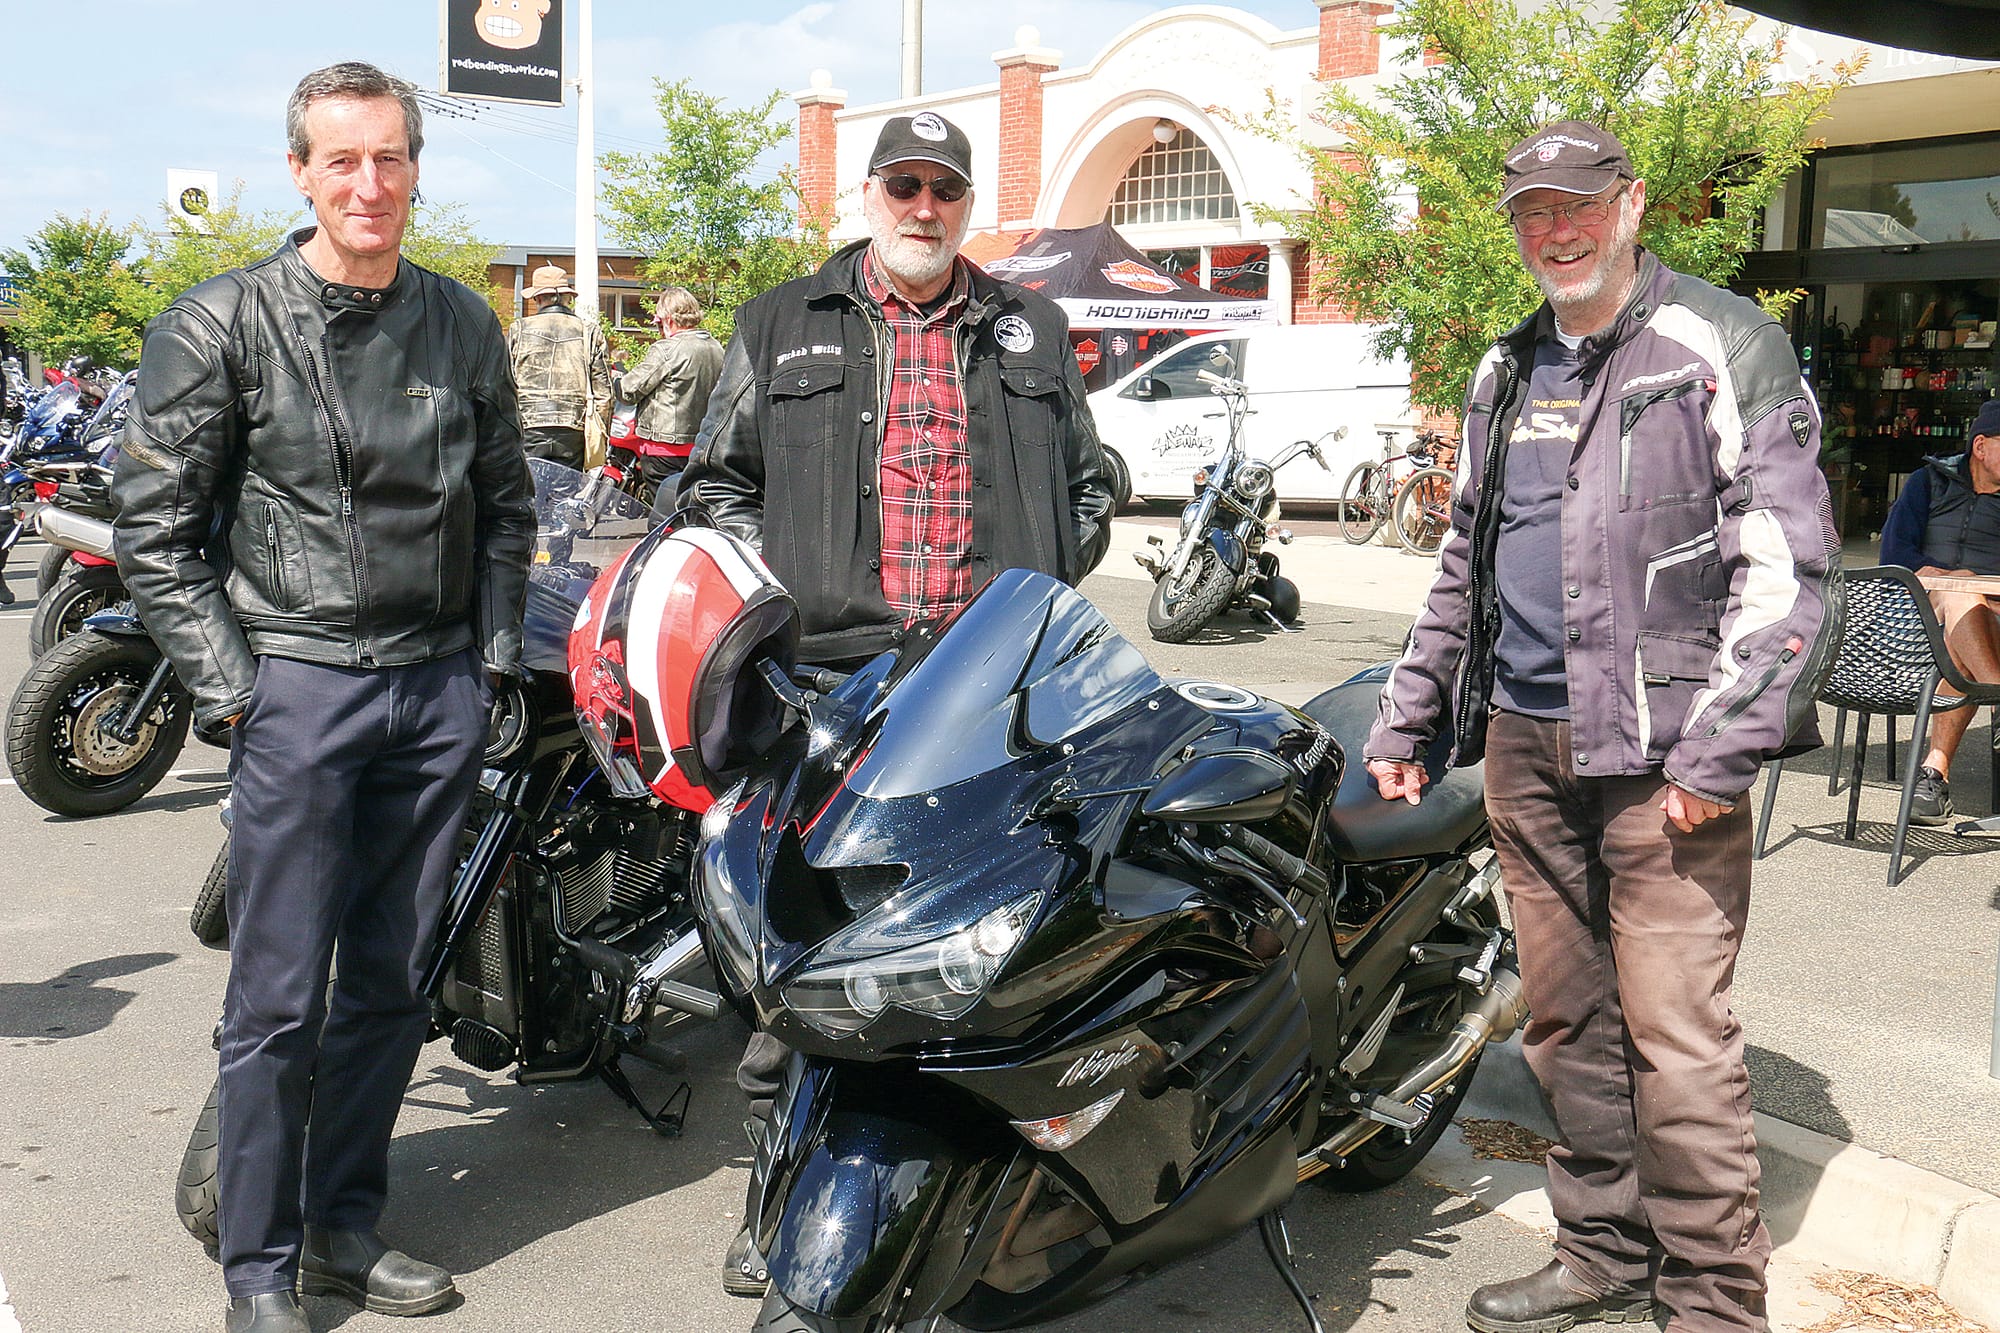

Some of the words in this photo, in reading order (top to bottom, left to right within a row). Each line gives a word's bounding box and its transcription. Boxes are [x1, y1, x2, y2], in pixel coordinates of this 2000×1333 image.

[451, 58, 559, 79] rodbendingsworld.com
[1532, 400, 1550, 408] THE
[1549, 400, 1580, 409] ORIGINA
[1057, 1039, 1140, 1088] Ninja
